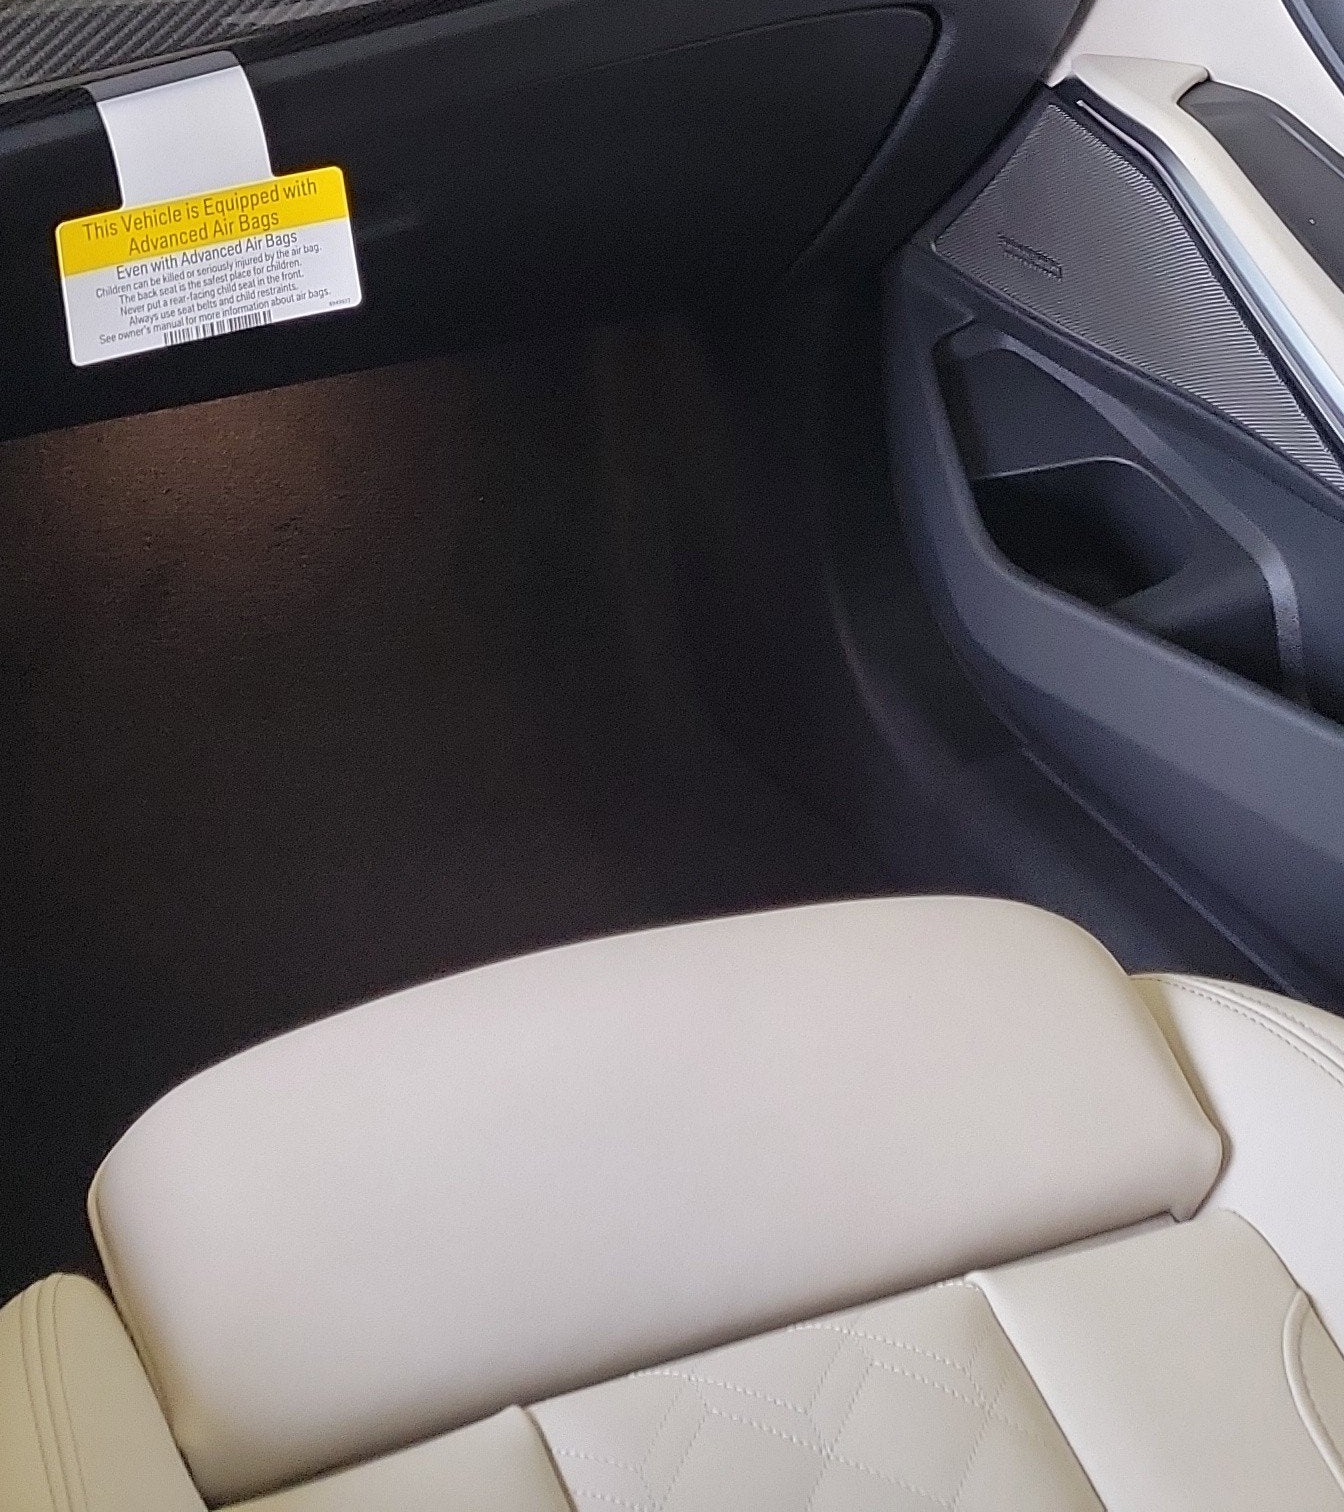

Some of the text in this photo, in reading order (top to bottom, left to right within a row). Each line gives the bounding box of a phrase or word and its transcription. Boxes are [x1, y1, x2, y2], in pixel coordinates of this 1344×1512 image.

[82, 178, 317, 241] This Vehicle is Equipped with
[116, 232, 298, 280] Even with Advanced Air Bags
[129, 212, 280, 256] Advanced Air Bags
[95, 243, 322, 299] Children can be killed or seriously injured by the air bag.
[119, 258, 302, 304] The back seat is the safest place for children.
[120, 269, 304, 316] Never put a rear-facing child seat in the front.
[99, 287, 331, 345] See owner's manual for more information about air bags.
[129, 282, 299, 326] Always use seat belts and child restraints.
